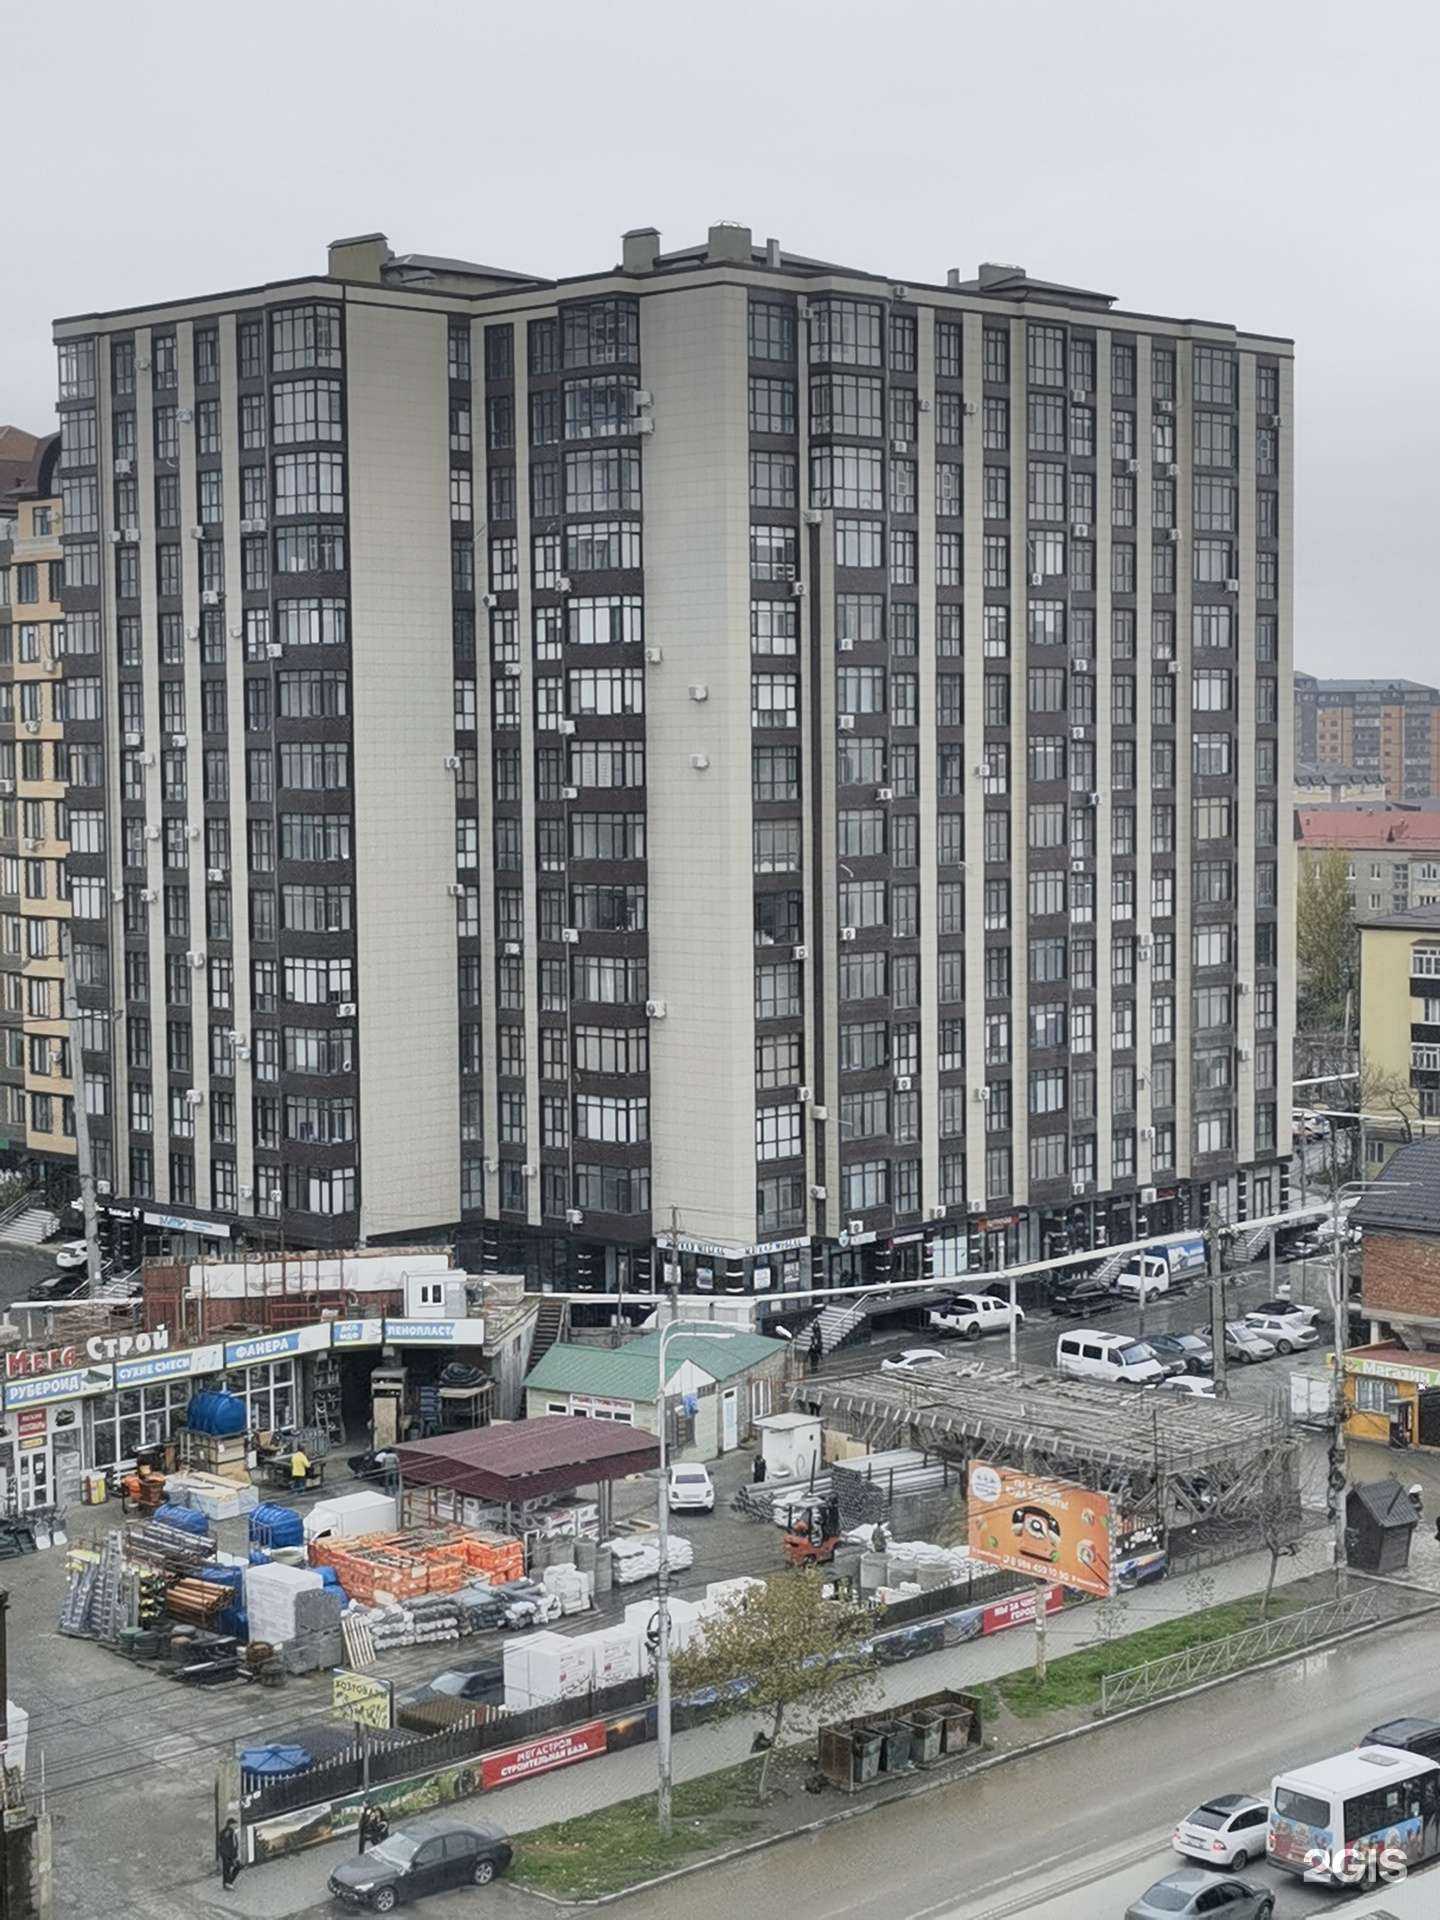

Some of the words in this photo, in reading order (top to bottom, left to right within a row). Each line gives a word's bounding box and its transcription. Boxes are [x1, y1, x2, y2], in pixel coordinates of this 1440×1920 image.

[387, 1325, 452, 1337] ПЕНОПЛАСТ
[235, 1336, 289, 1359] ФАНЕРА
[118, 1365, 154, 1379] СУХИЕ
[155, 1357, 190, 1374] СМЕСИ
[9, 1376, 80, 1400] РУБЕРОИД
[501, 1748, 567, 1777] СТРОИТЕЛЬНАЯ
[566, 1742, 589, 1758] БАЗА
